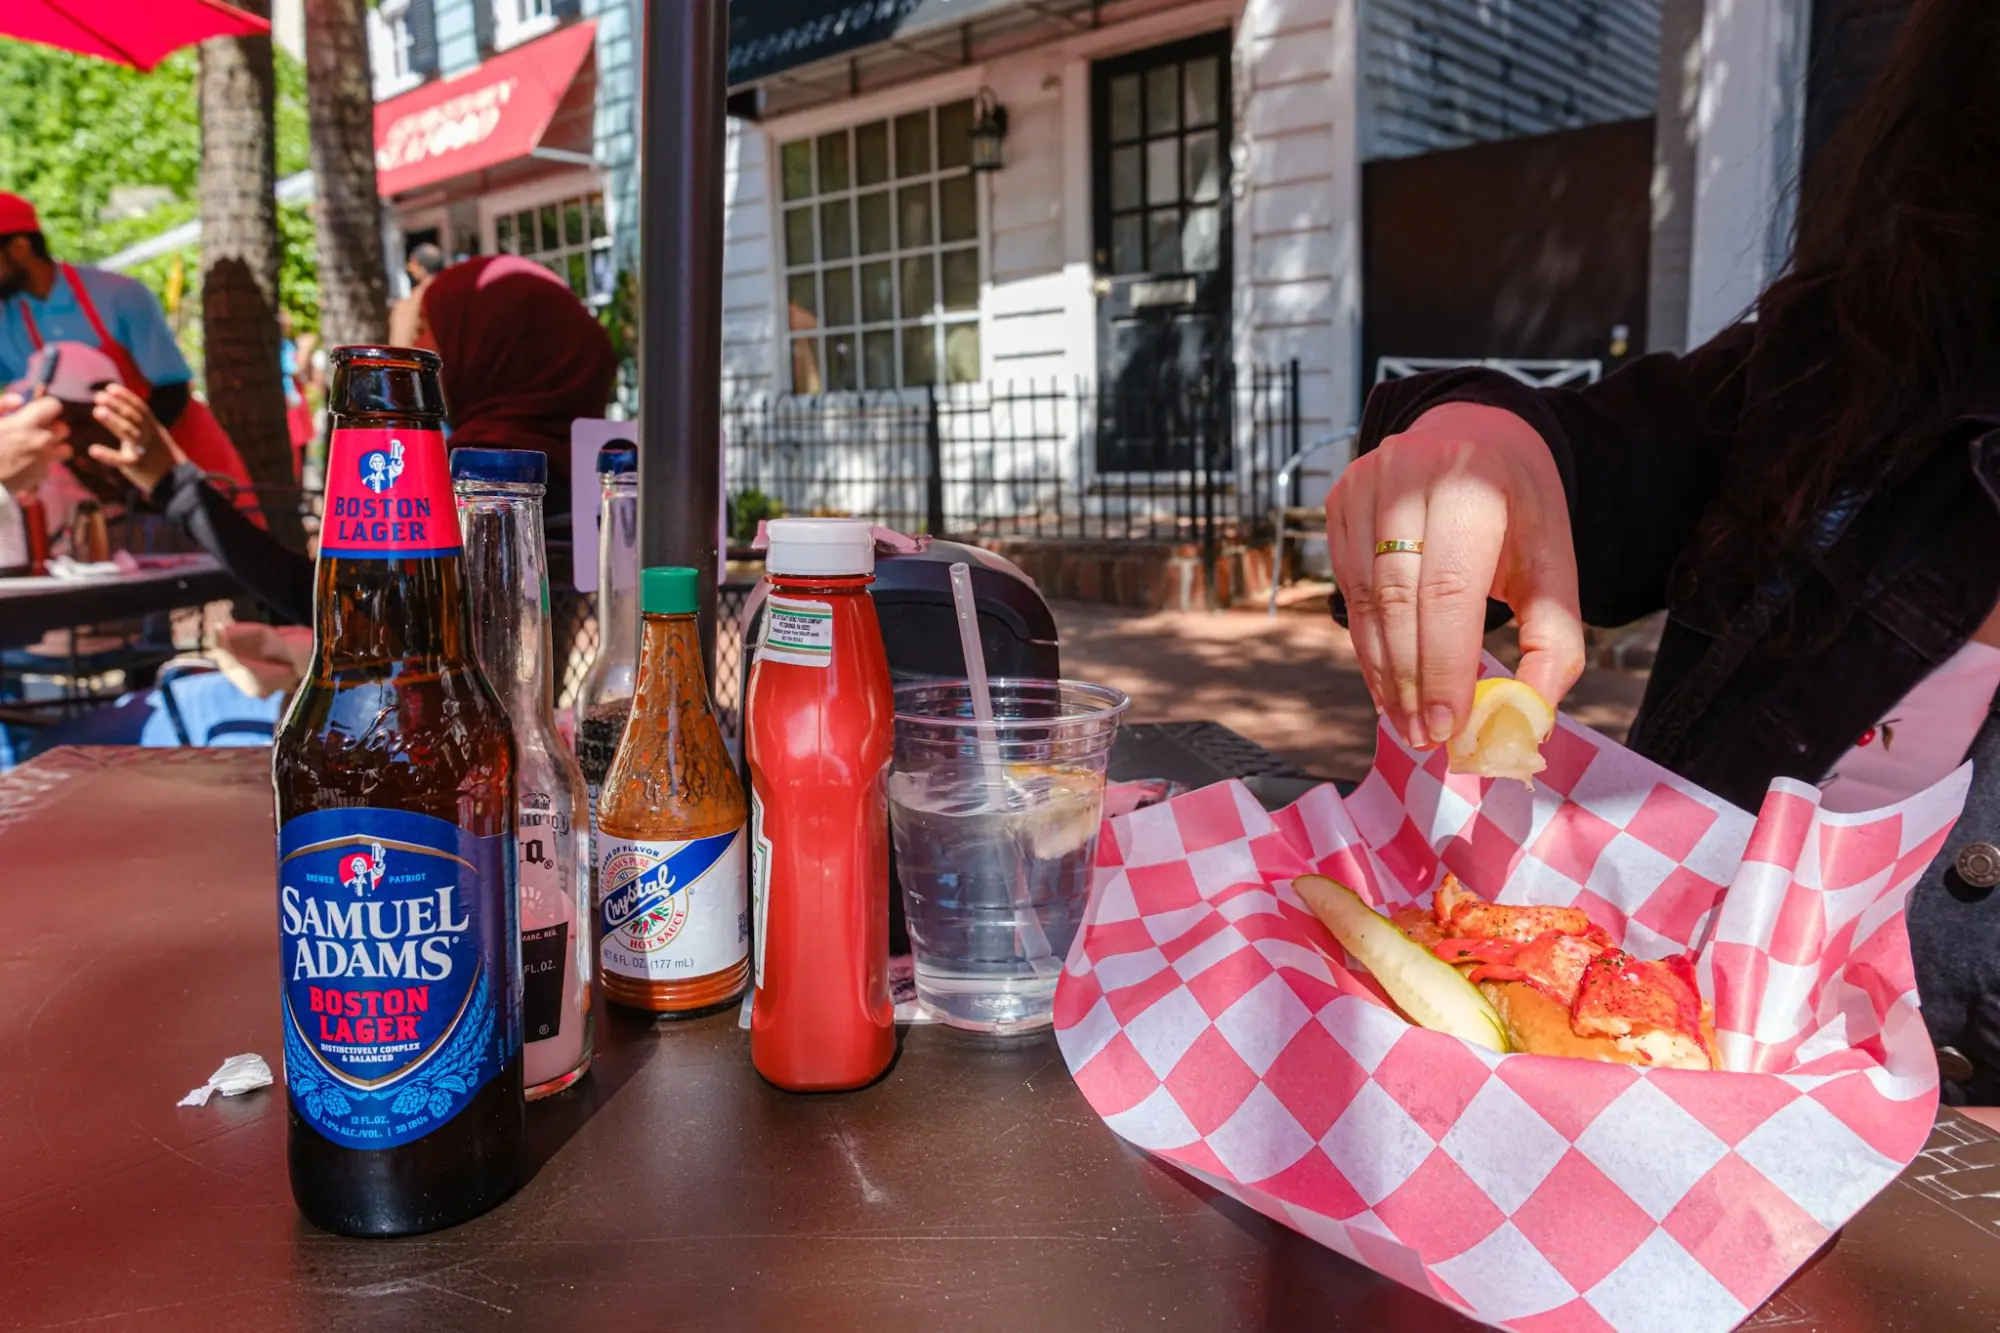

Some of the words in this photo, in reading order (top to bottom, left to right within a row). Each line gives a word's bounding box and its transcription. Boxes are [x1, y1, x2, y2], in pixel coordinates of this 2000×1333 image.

[334, 497, 431, 517] BOSTON
[337, 521, 427, 541] LAGER
[612, 847, 620, 855] OF
[623, 846, 659, 857] FLAVOR
[306, 873, 335, 884] BREWER
[388, 872, 427, 884] PATRIOT
[605, 864, 676, 926] Crystal
[282, 885, 470, 940] SAMUEL
[629, 939, 653, 950] HOT
[657, 910, 685, 944] SAUCE
[293, 936, 454, 982] ADAMS
[613, 953, 618, 964] 6
[650, 959, 671, 971] (177
[675, 957, 694, 969] mL)
[308, 985, 430, 1018] BOSTON
[320, 1015, 420, 1043] LAGER
[320, 1043, 378, 1054] DISTINCTIVELY
[380, 1042, 420, 1054] COMPLEX
[349, 1054, 394, 1063] BALANCED
[351, 1116, 359, 1124] 12
[407, 1115, 429, 1130] IBUs
